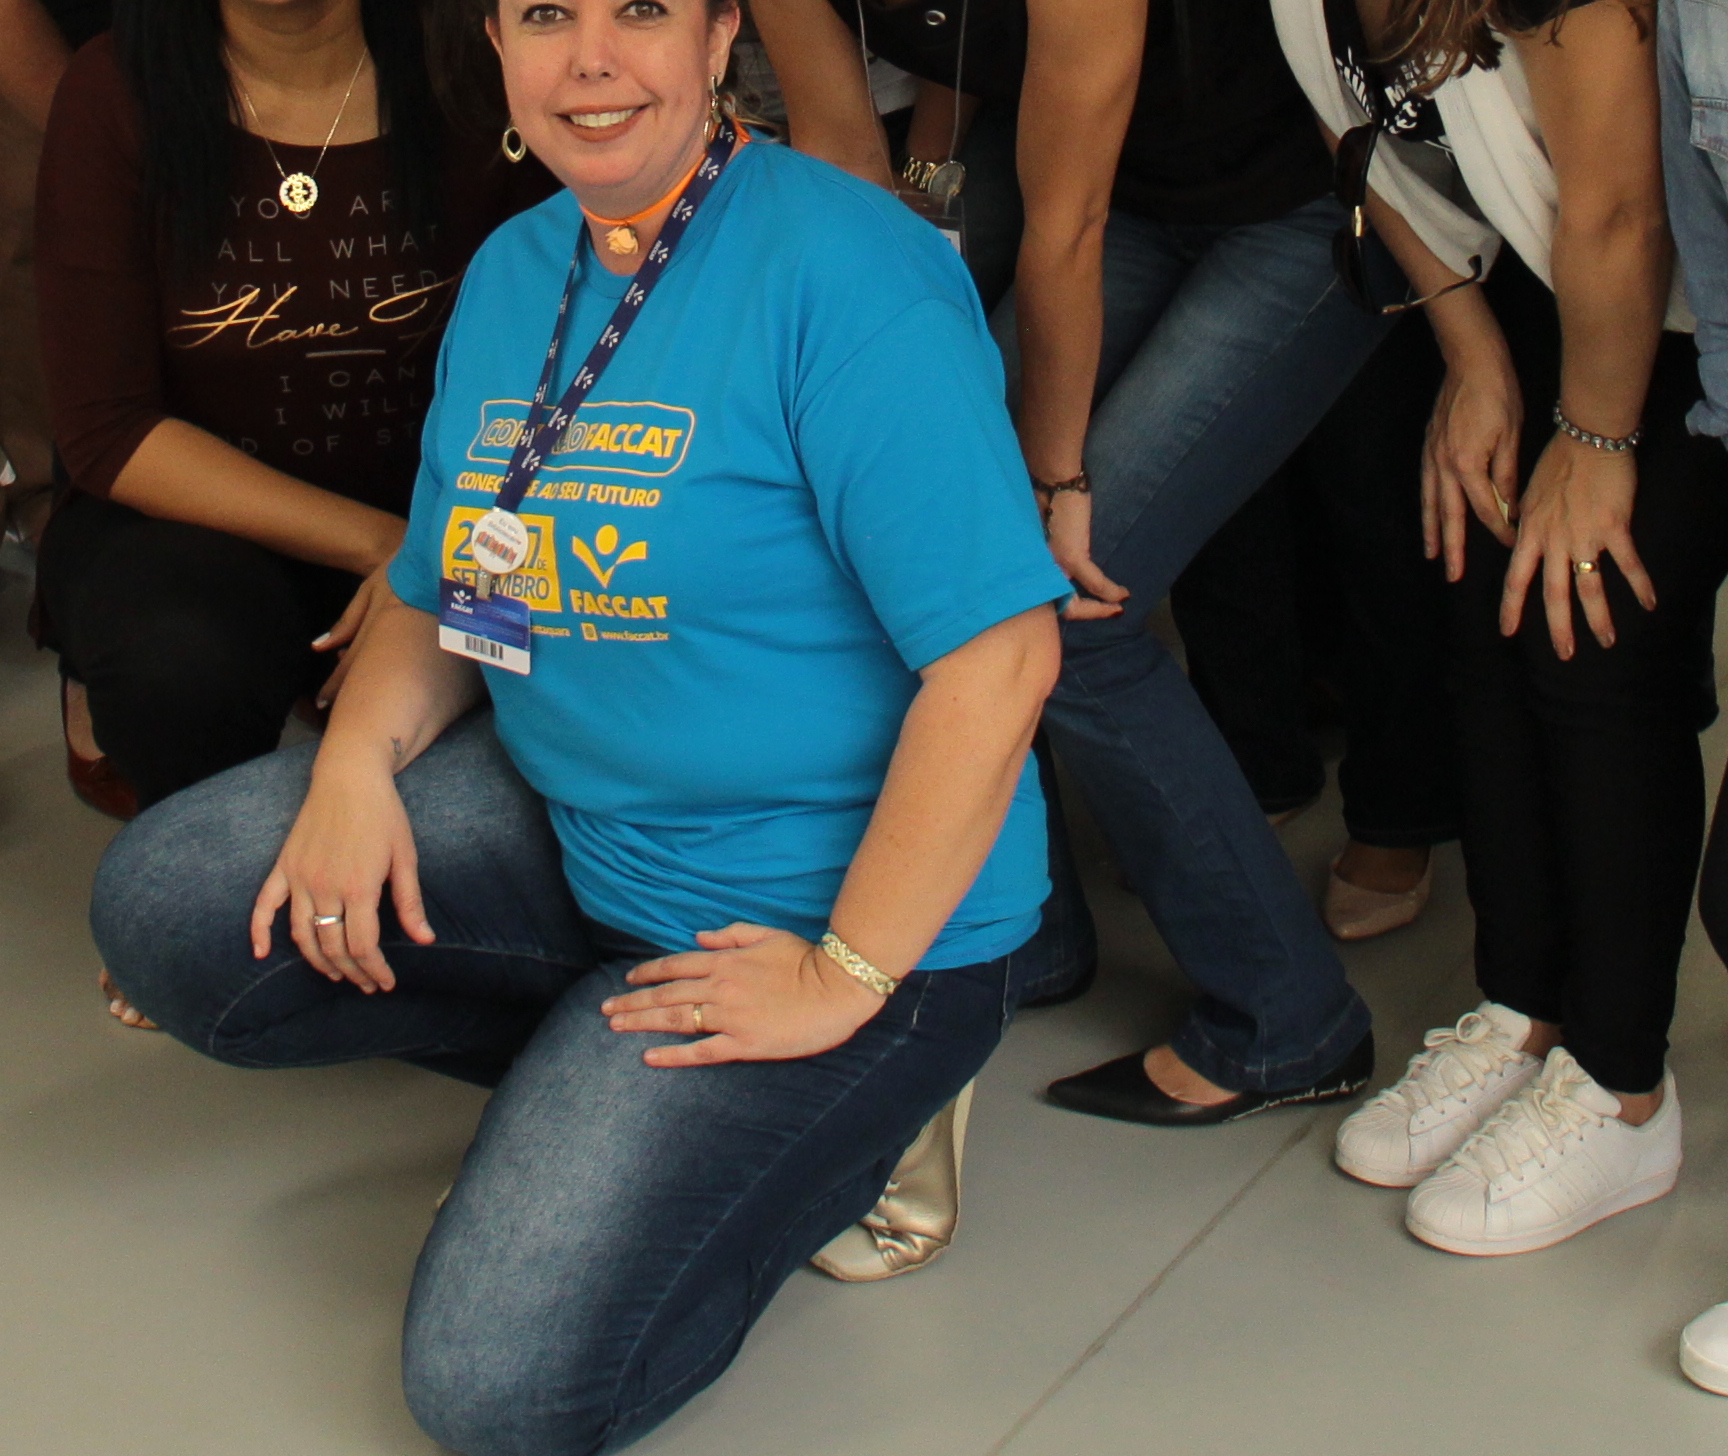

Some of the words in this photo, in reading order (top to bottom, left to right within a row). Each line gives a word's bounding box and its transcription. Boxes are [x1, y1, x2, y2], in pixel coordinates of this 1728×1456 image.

[217, 238, 292, 262] ALL
[329, 225, 439, 260] WHAT
[212, 281, 292, 305] YOU
[329, 270, 438, 299] NEED
[167, 285, 359, 349] Have
[481, 414, 683, 458] CONOFACCAT
[560, 481, 585, 500] SEU
[586, 484, 662, 507] FUTURO
[537, 558, 547, 570] DE
[569, 588, 669, 619] FACCAT
